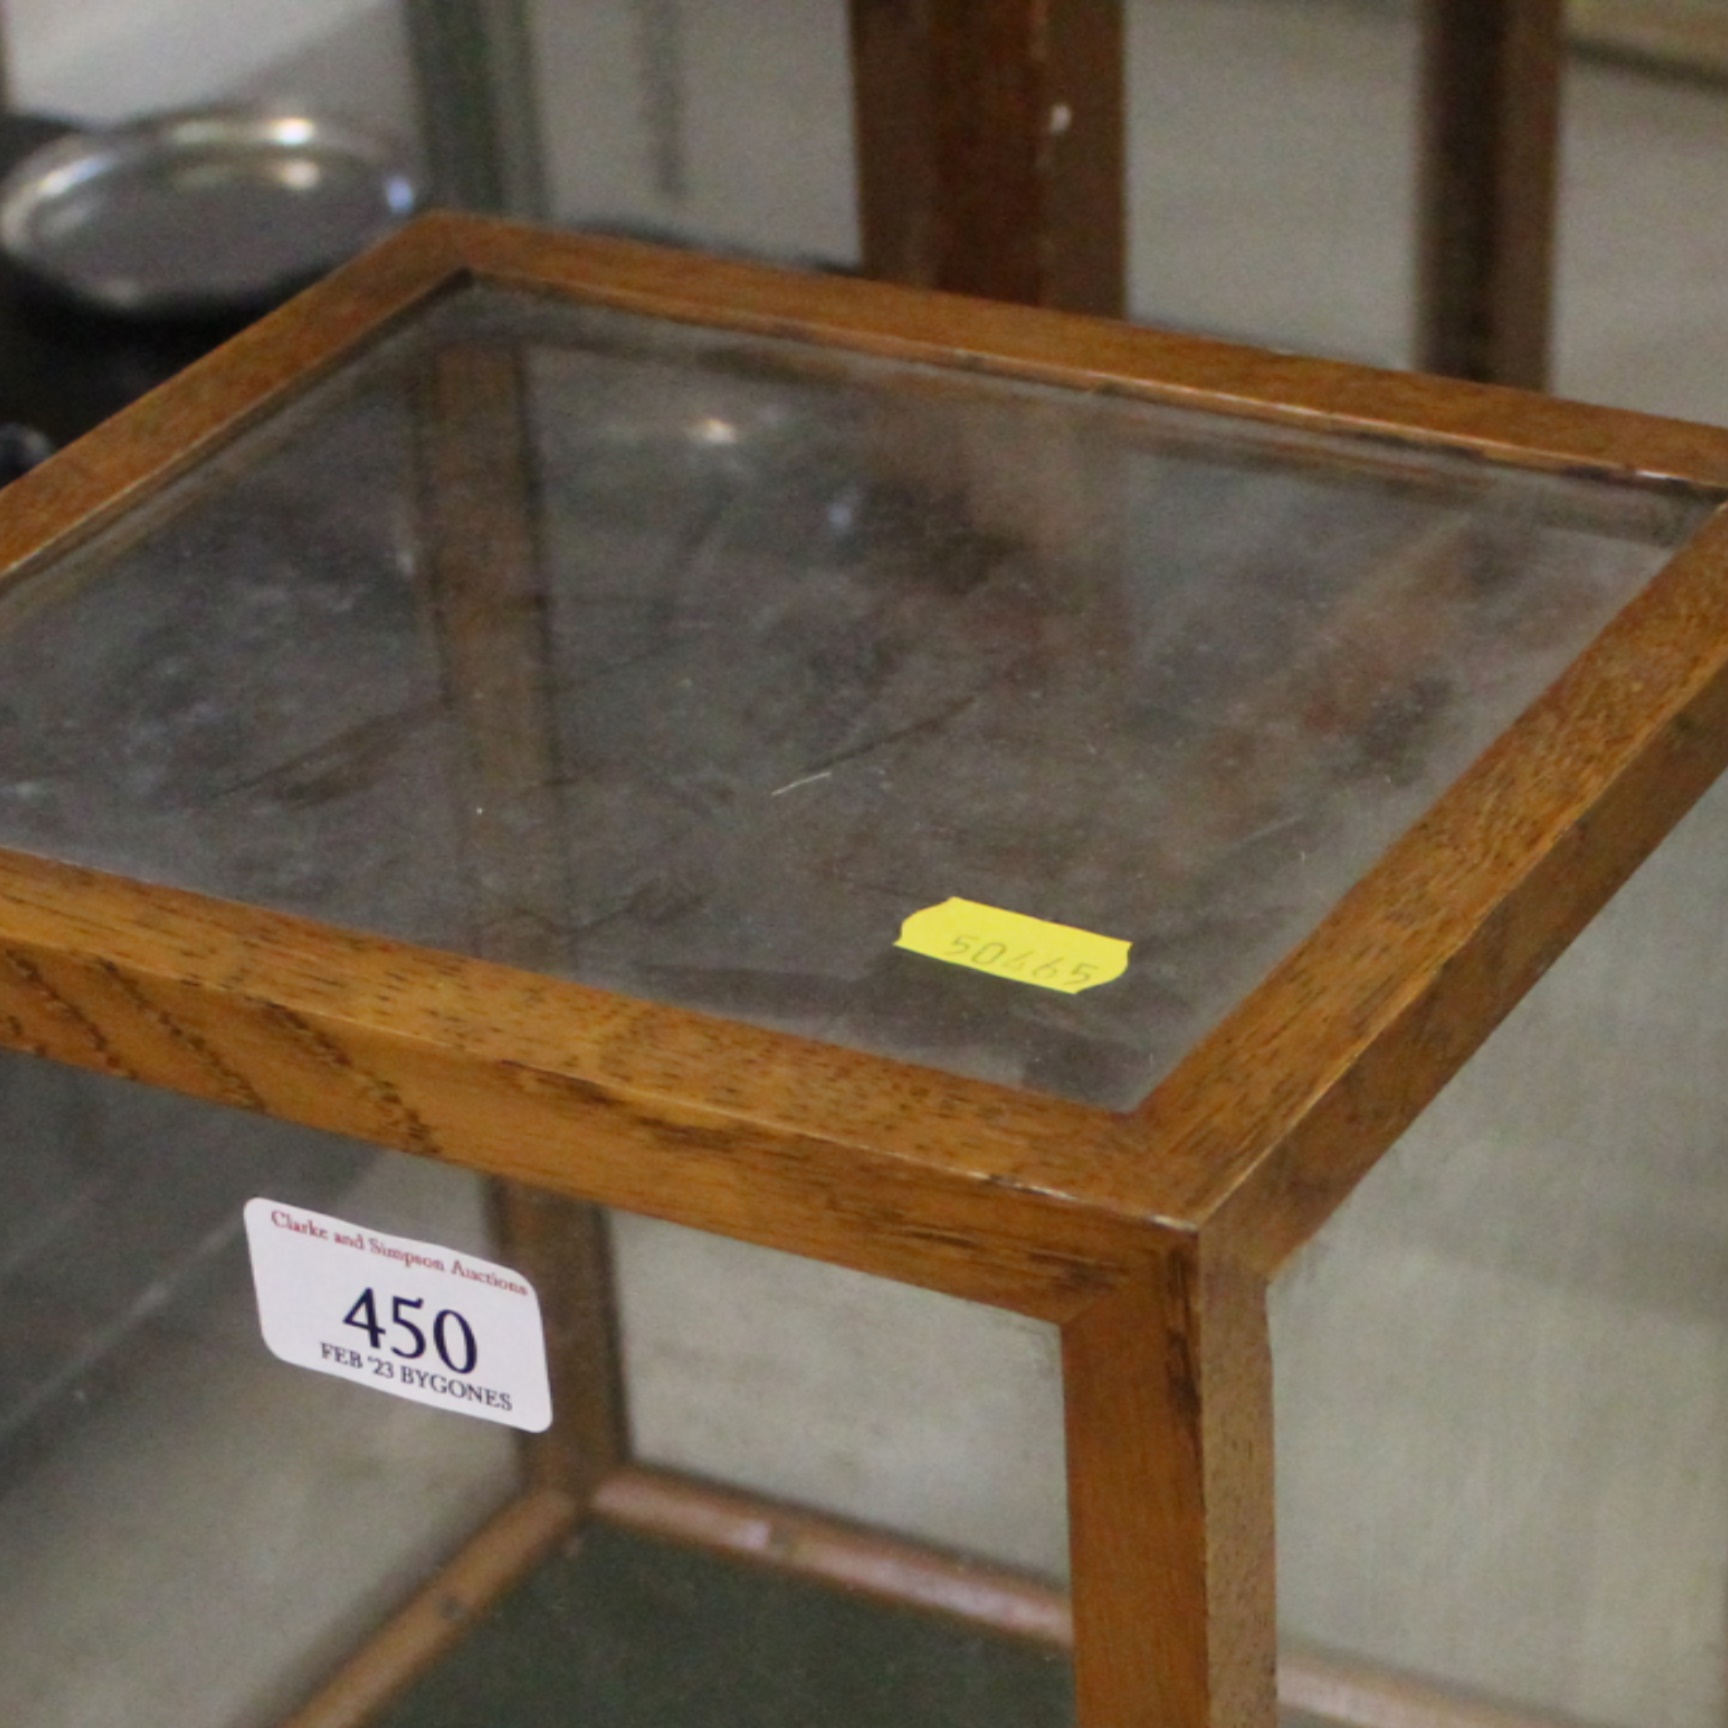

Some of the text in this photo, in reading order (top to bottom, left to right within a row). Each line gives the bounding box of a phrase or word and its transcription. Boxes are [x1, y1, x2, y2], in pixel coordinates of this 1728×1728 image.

[270, 1209, 529, 1296] Clarke and Simpson Auctions
[342, 1286, 479, 1376] 450
[319, 1341, 364, 1370] FEB
[400, 1367, 513, 1412] BYGONES
